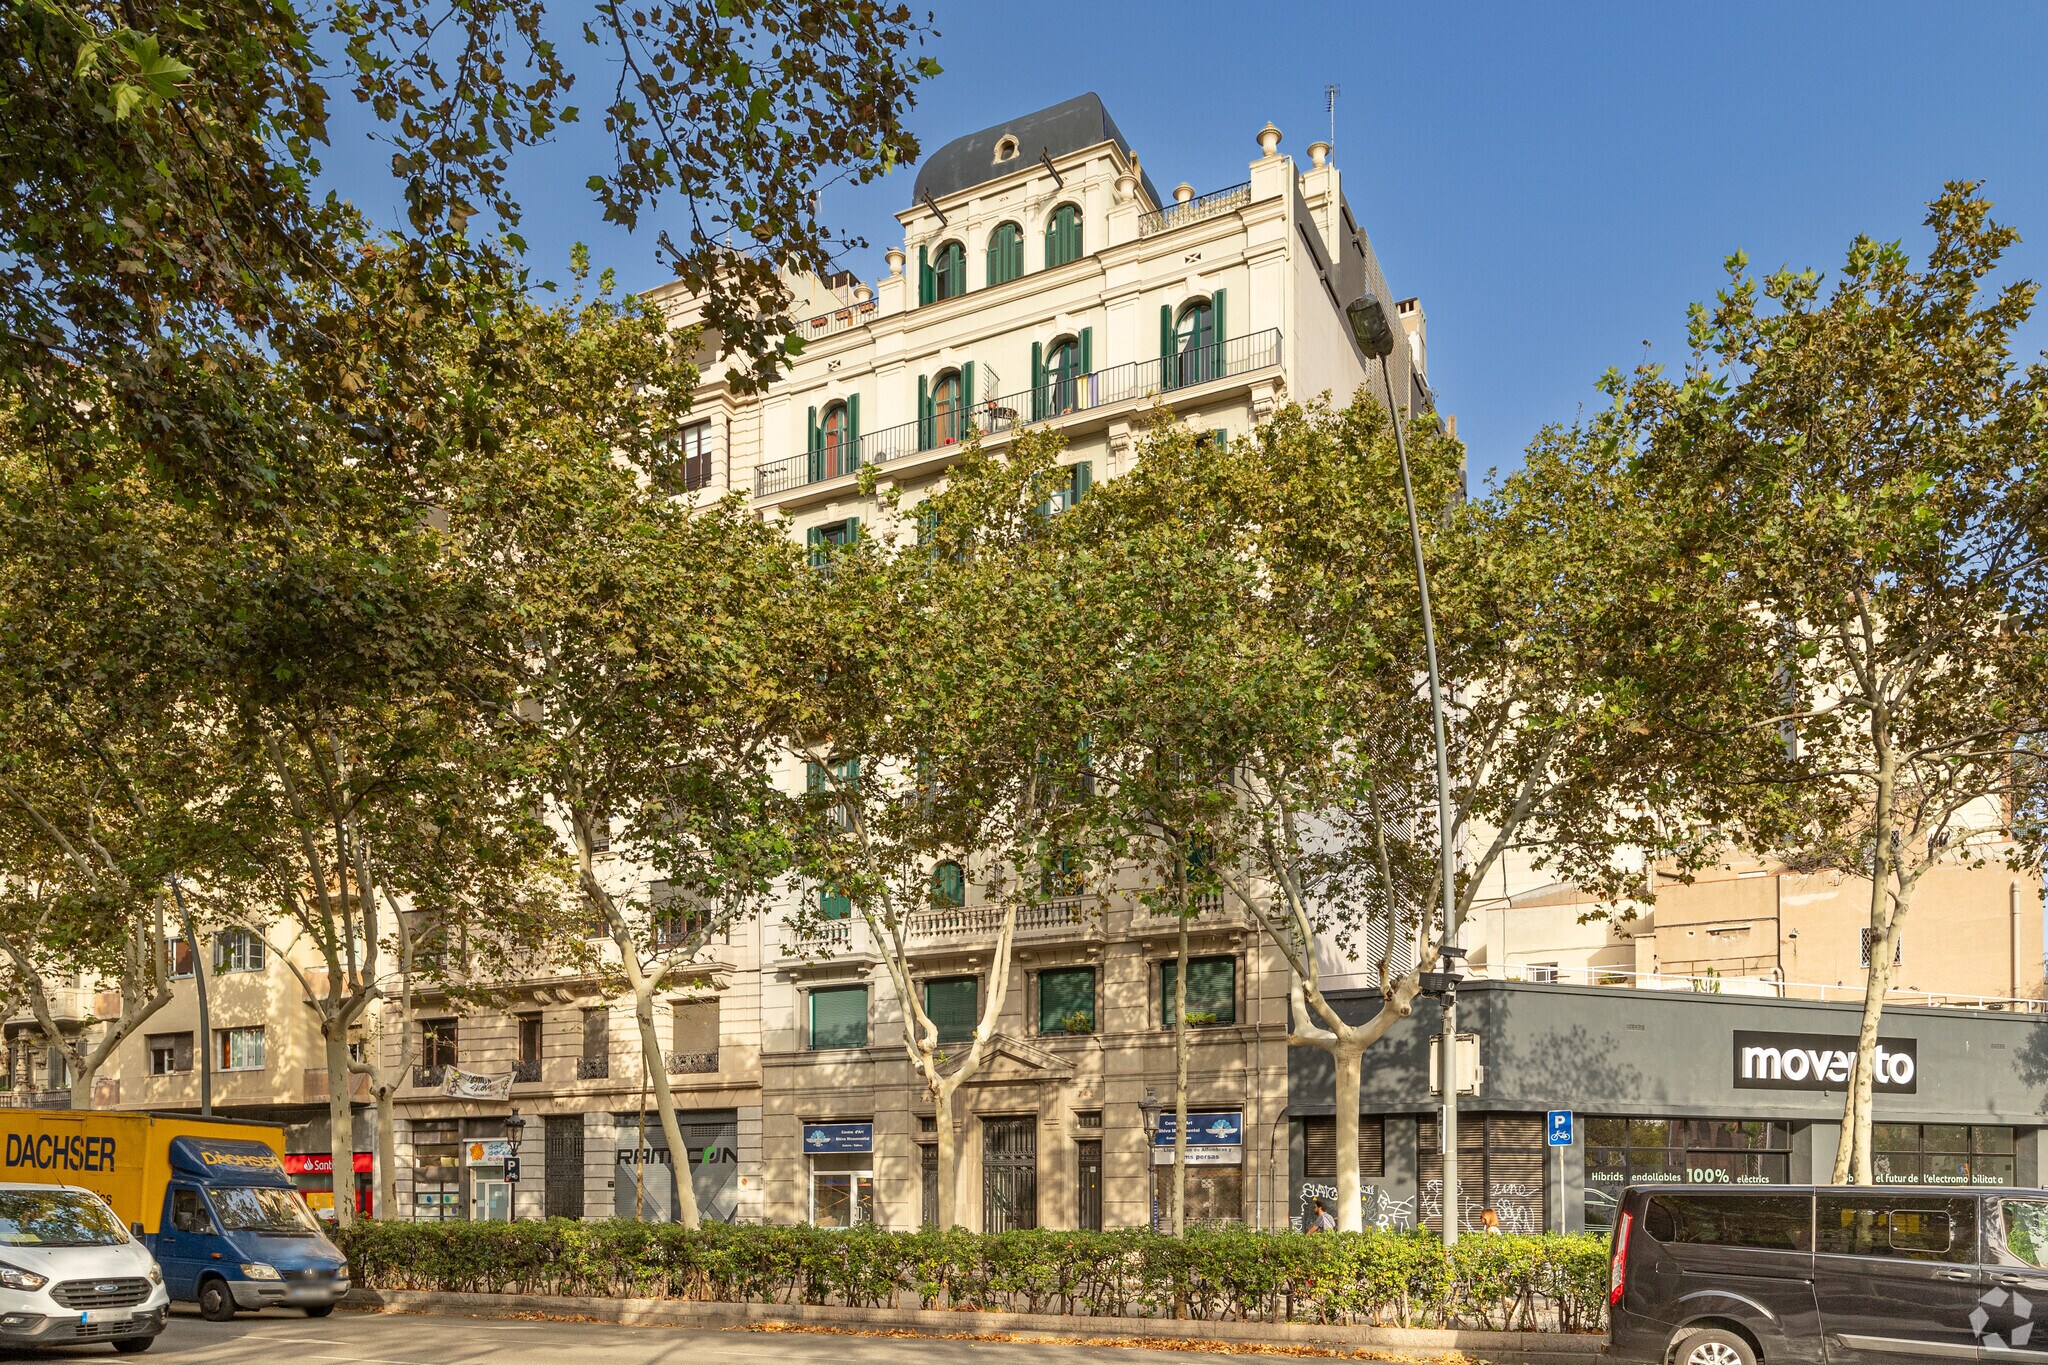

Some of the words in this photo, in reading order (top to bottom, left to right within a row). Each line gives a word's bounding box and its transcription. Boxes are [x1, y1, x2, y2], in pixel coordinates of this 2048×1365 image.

[1554, 1115, 1566, 1129] P
[6, 1133, 116, 1172] DACHSER
[201, 1151, 281, 1169] DACHSER
[616, 1147, 738, 1165] RAMCON
[507, 1160, 516, 1170] P
[1591, 1171, 1624, 1181] Híbrids
[1631, 1172, 1681, 1182] endollables
[1686, 1168, 1729, 1183] 100%
[1736, 1175, 1770, 1184] elèctrics
[1875, 1173, 1884, 1183] el
[1885, 1173, 1907, 1183] futur
[1908, 1174, 1918, 1183] de
